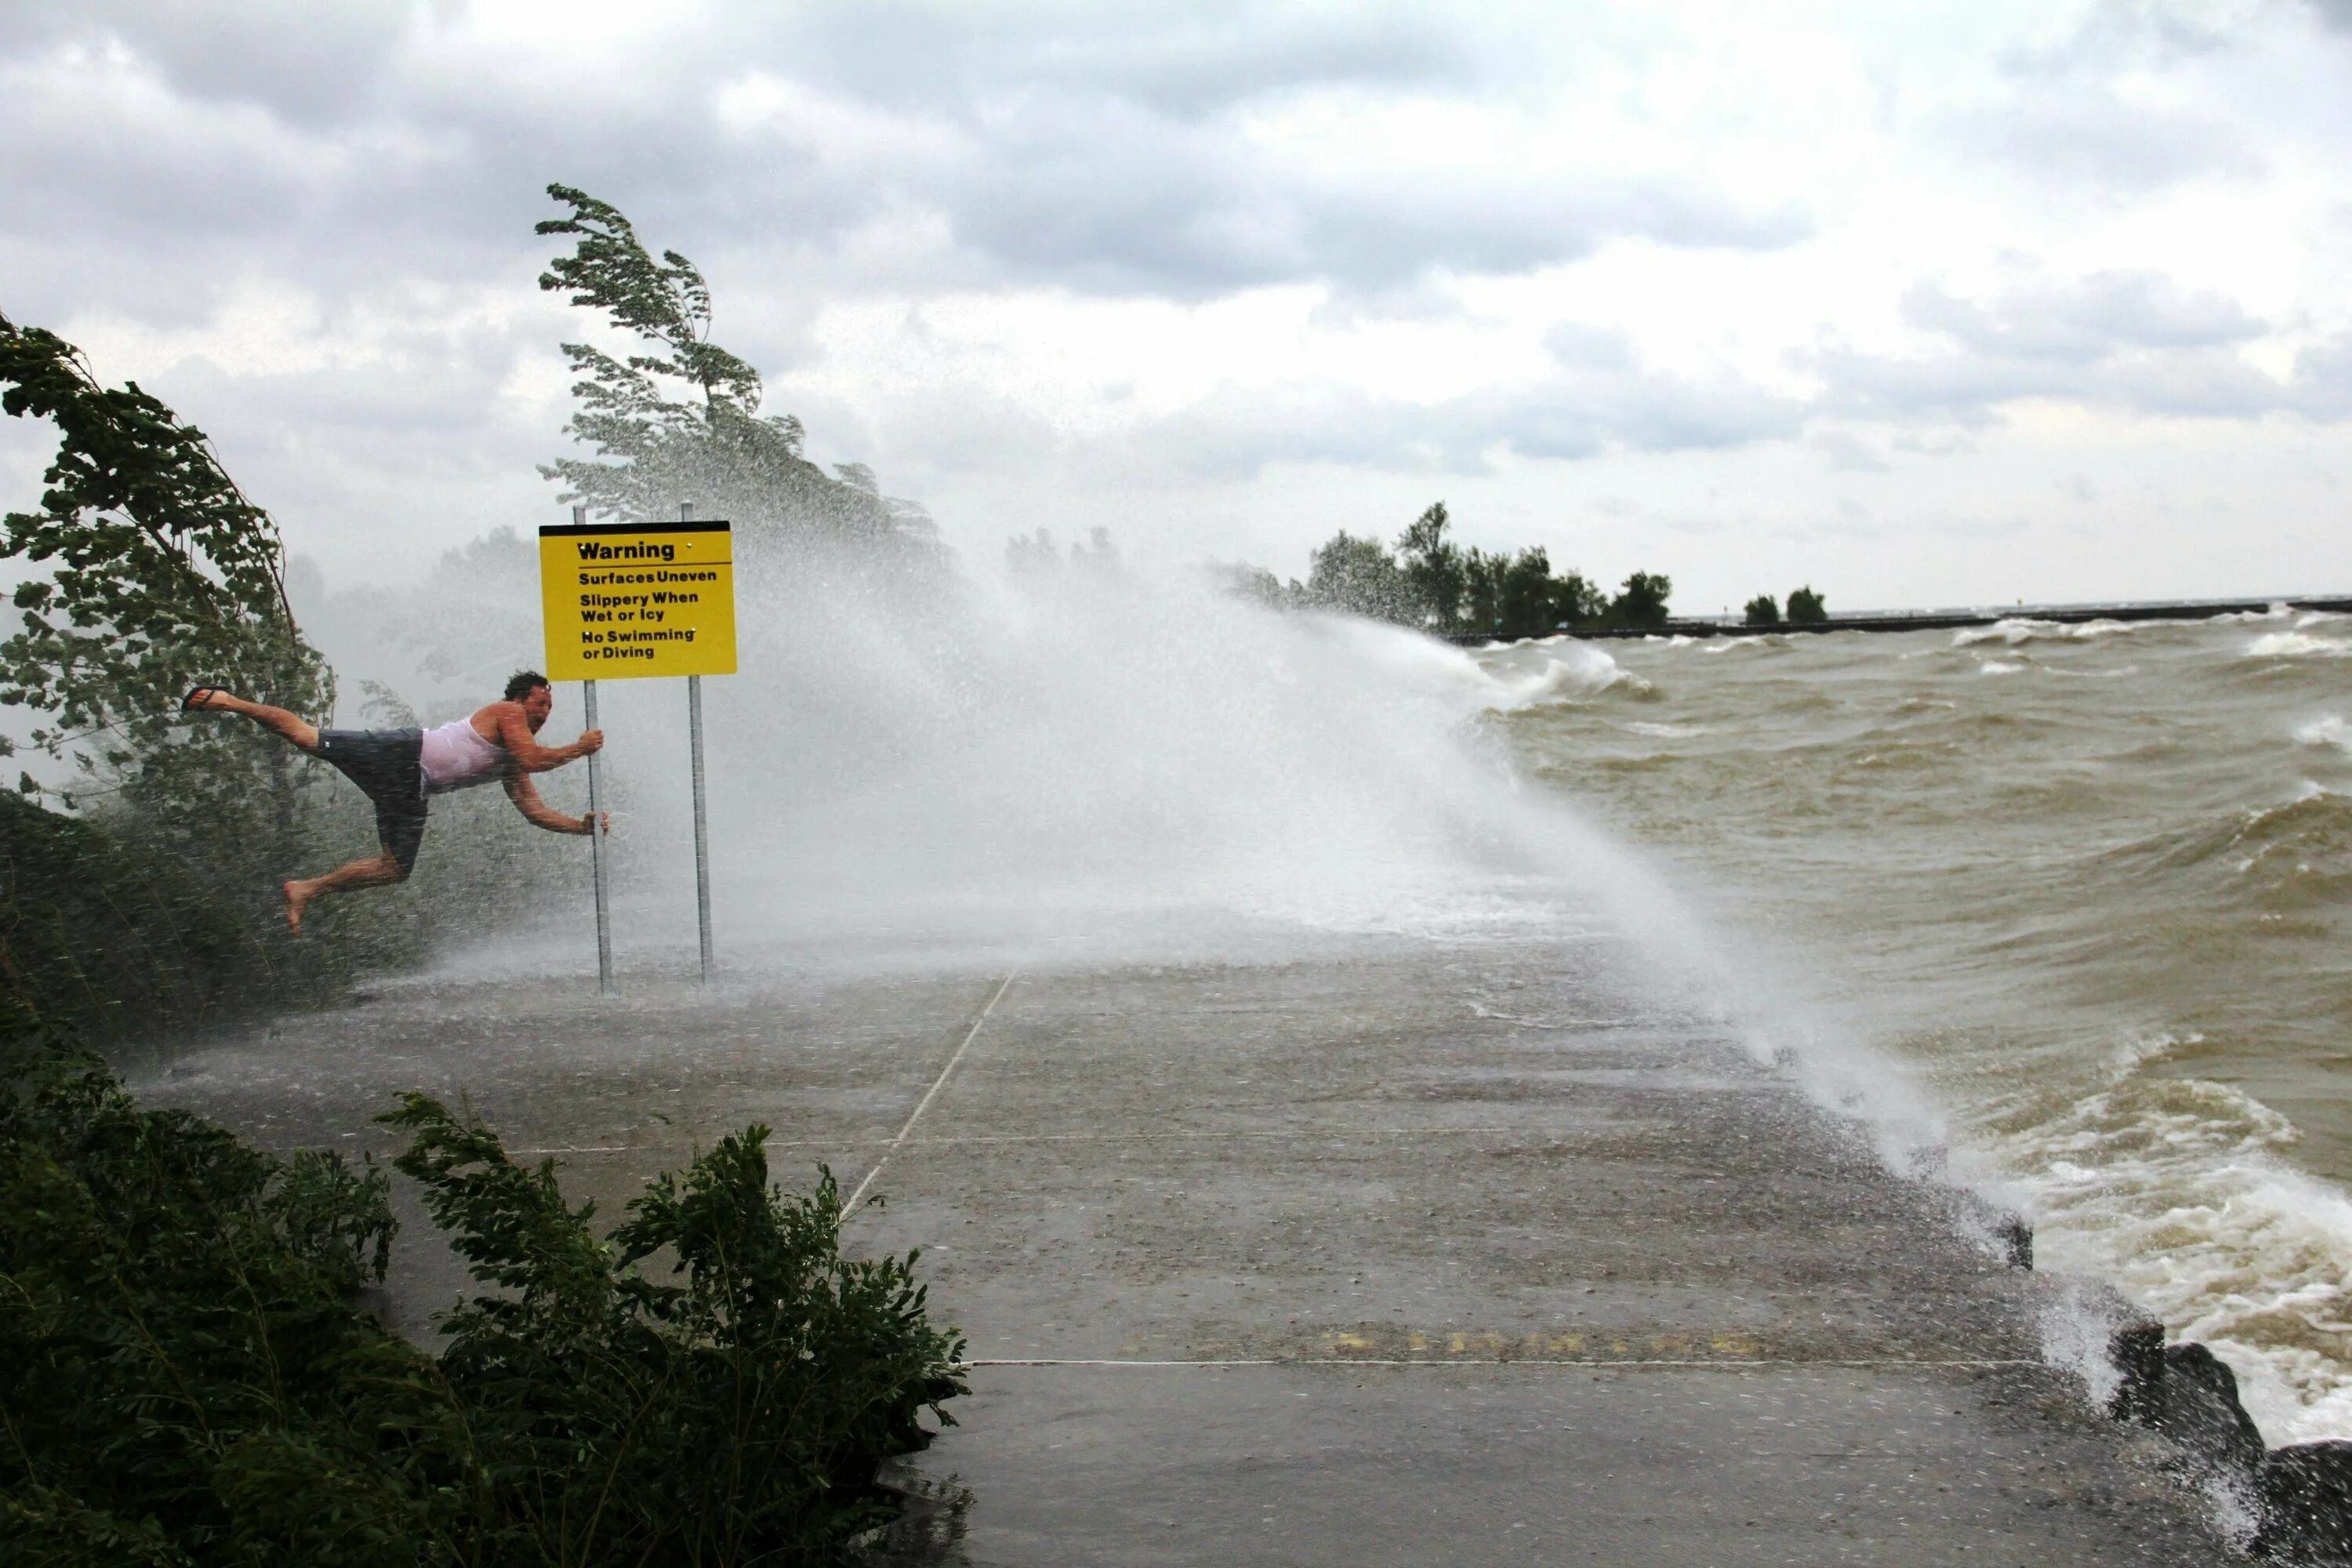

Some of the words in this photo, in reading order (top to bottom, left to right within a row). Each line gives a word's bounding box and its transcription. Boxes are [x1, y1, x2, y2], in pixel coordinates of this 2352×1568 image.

[577, 541, 674, 561] Warning
[579, 572, 655, 585] Surfaces
[657, 570, 717, 582] Uneven
[580, 593, 649, 608] Slippery
[652, 592, 699, 603] When
[581, 610, 613, 622] Wet
[618, 612, 635, 621] or
[641, 608, 665, 622] Icy
[582, 631, 604, 644] No
[607, 629, 695, 642] Swimming
[583, 650, 600, 659] or
[602, 647, 655, 659] Diving
